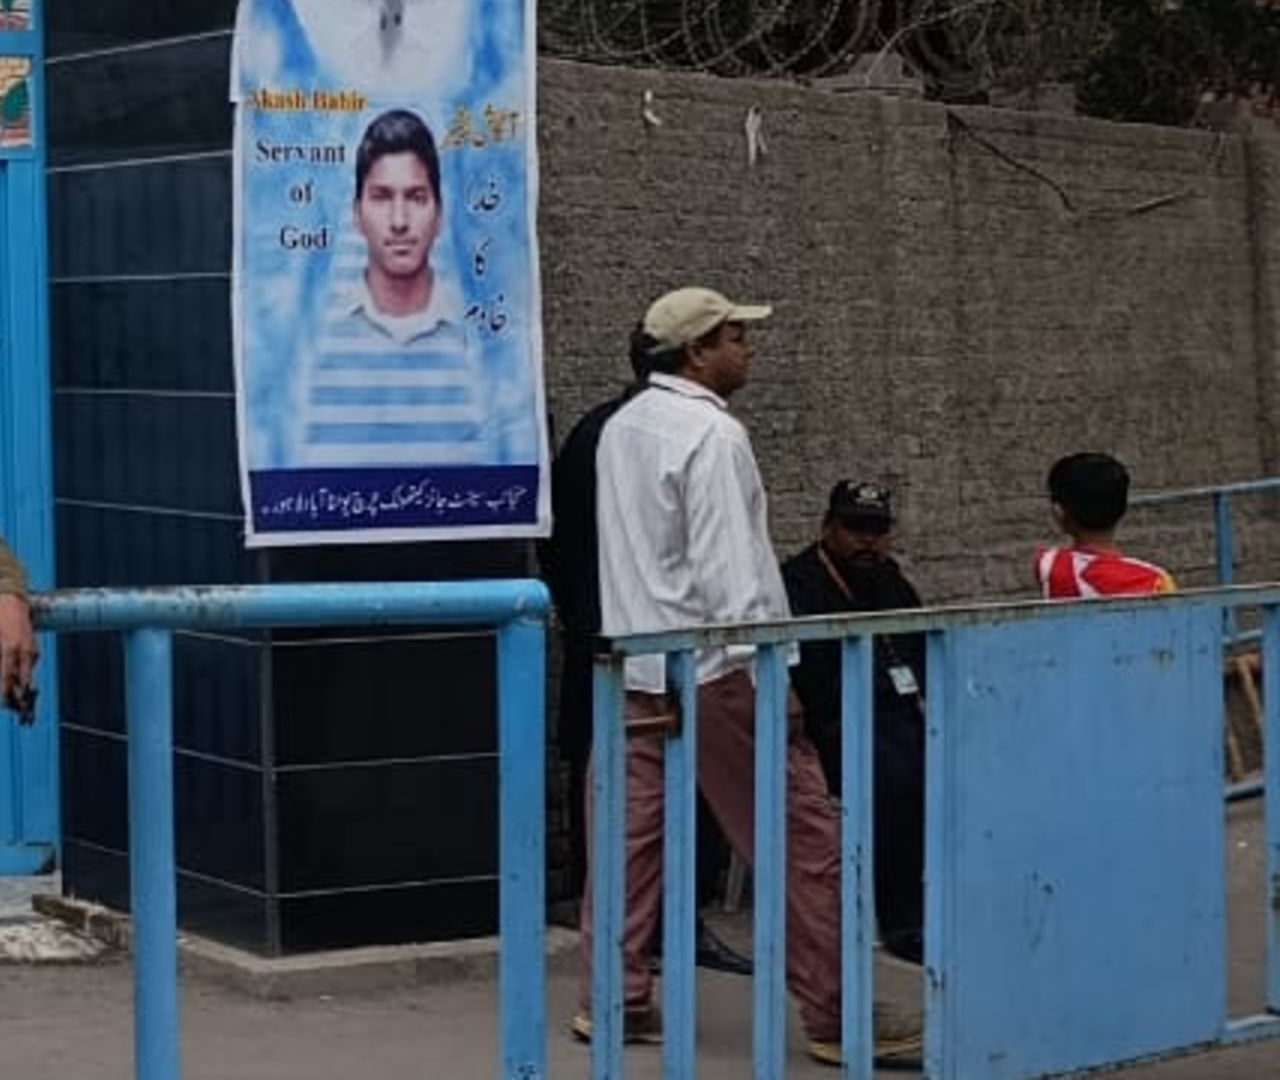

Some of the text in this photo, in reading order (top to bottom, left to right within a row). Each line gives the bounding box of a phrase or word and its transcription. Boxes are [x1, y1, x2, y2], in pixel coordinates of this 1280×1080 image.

[256, 139, 346, 164] Servant
[290, 179, 313, 203] of
[280, 226, 329, 250] God
